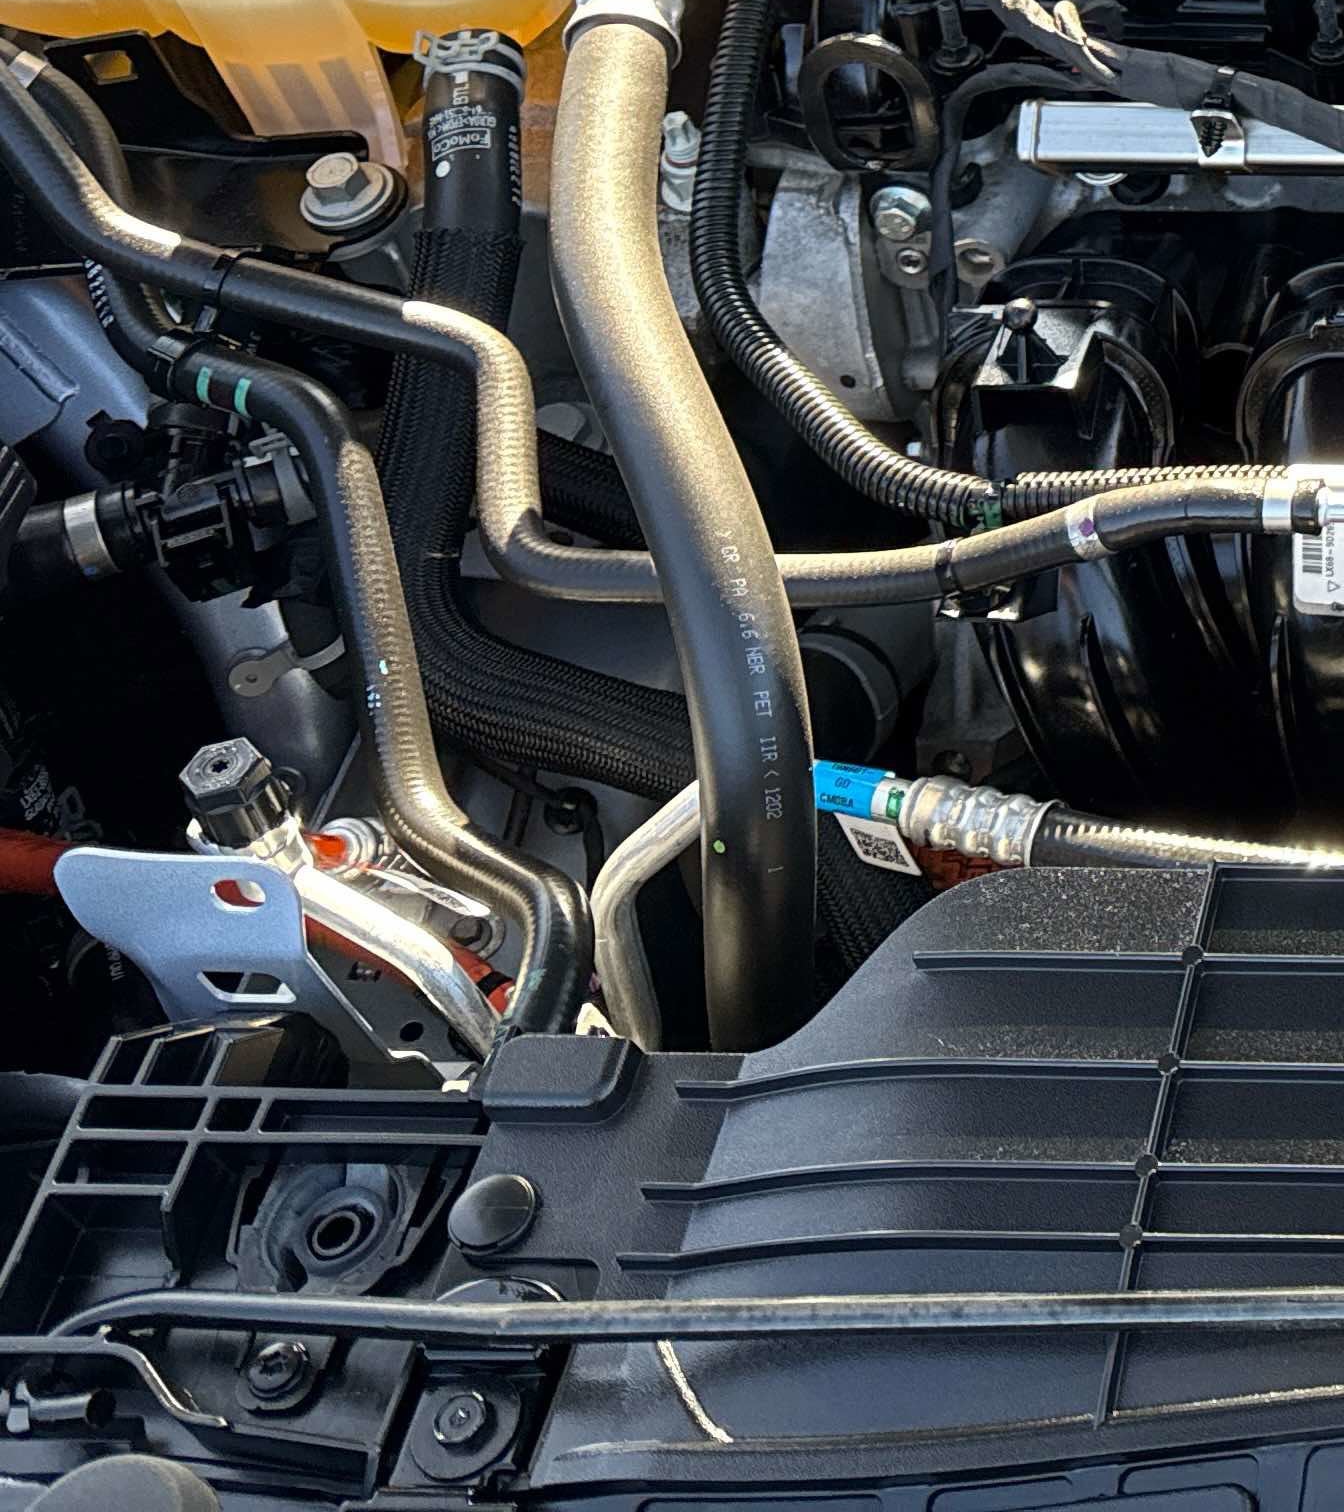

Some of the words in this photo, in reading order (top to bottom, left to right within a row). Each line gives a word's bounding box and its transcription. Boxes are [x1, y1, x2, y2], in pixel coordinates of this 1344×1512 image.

[433, 132, 489, 154] FoMoCo
[738, 612, 761, 640] 6.6
[745, 646, 767, 676] NBR
[752, 690, 773, 718] PET
[764, 787, 783, 820] 1202
